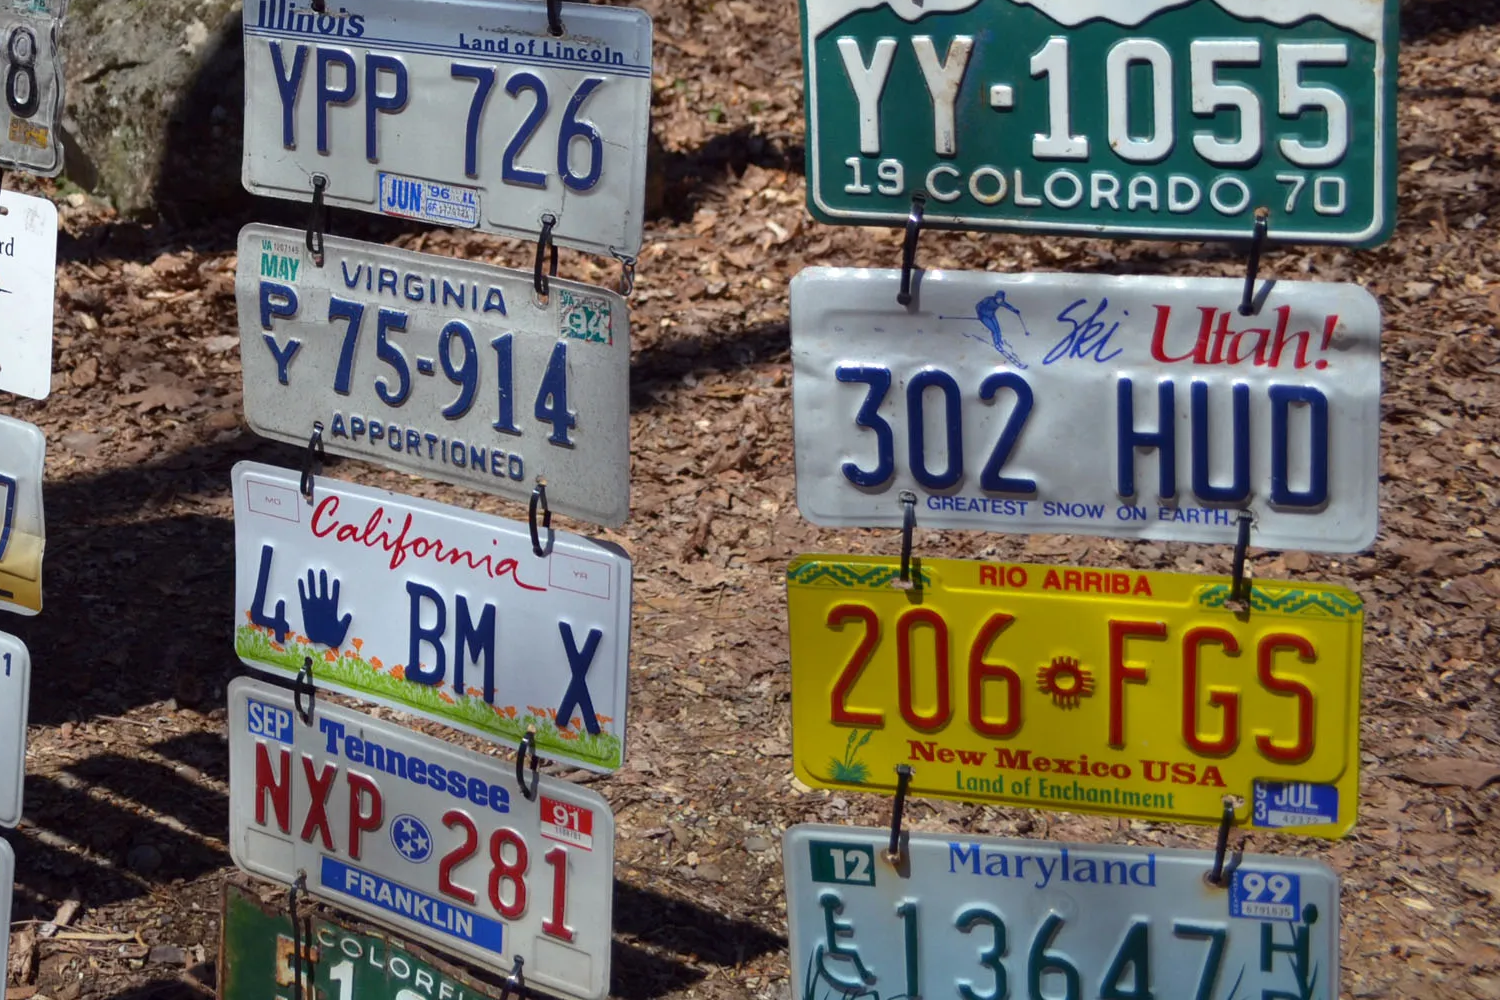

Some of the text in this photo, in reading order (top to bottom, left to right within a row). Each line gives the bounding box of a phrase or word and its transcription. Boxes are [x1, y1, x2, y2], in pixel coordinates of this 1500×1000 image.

[459, 32, 624, 65] Land of Lincoln
[269, 40, 604, 192] YPP 726
[387, 179, 422, 212] JUN
[925, 164, 1346, 216] COLORADO 70
[261, 253, 300, 282] MAY
[340, 260, 507, 316] VIRGINIA
[1042, 296, 1340, 370] Ski Utah!
[328, 297, 576, 449] 75-914
[331, 413, 524, 482] APPORTIONED
[834, 366, 1328, 506] 302 HUD
[926, 494, 1148, 522] GREATEST SNOW ON
[310, 496, 547, 592] California
[979, 565, 1153, 598] RIO ARRIBA
[555, 621, 603, 736] X
[826, 603, 1317, 764] 206 FGS
[249, 703, 290, 740] SEP
[320, 716, 510, 813] Tennessee
[907, 739, 1227, 787] New Mexico USA
[956, 770, 1175, 810] Land of Enchantment
[255, 742, 575, 942] NXP 281
[829, 848, 870, 882] 12
[948, 842, 1156, 890] Maryland
[345, 868, 473, 939] FRANKLIN
[1242, 873, 1291, 902] 99
